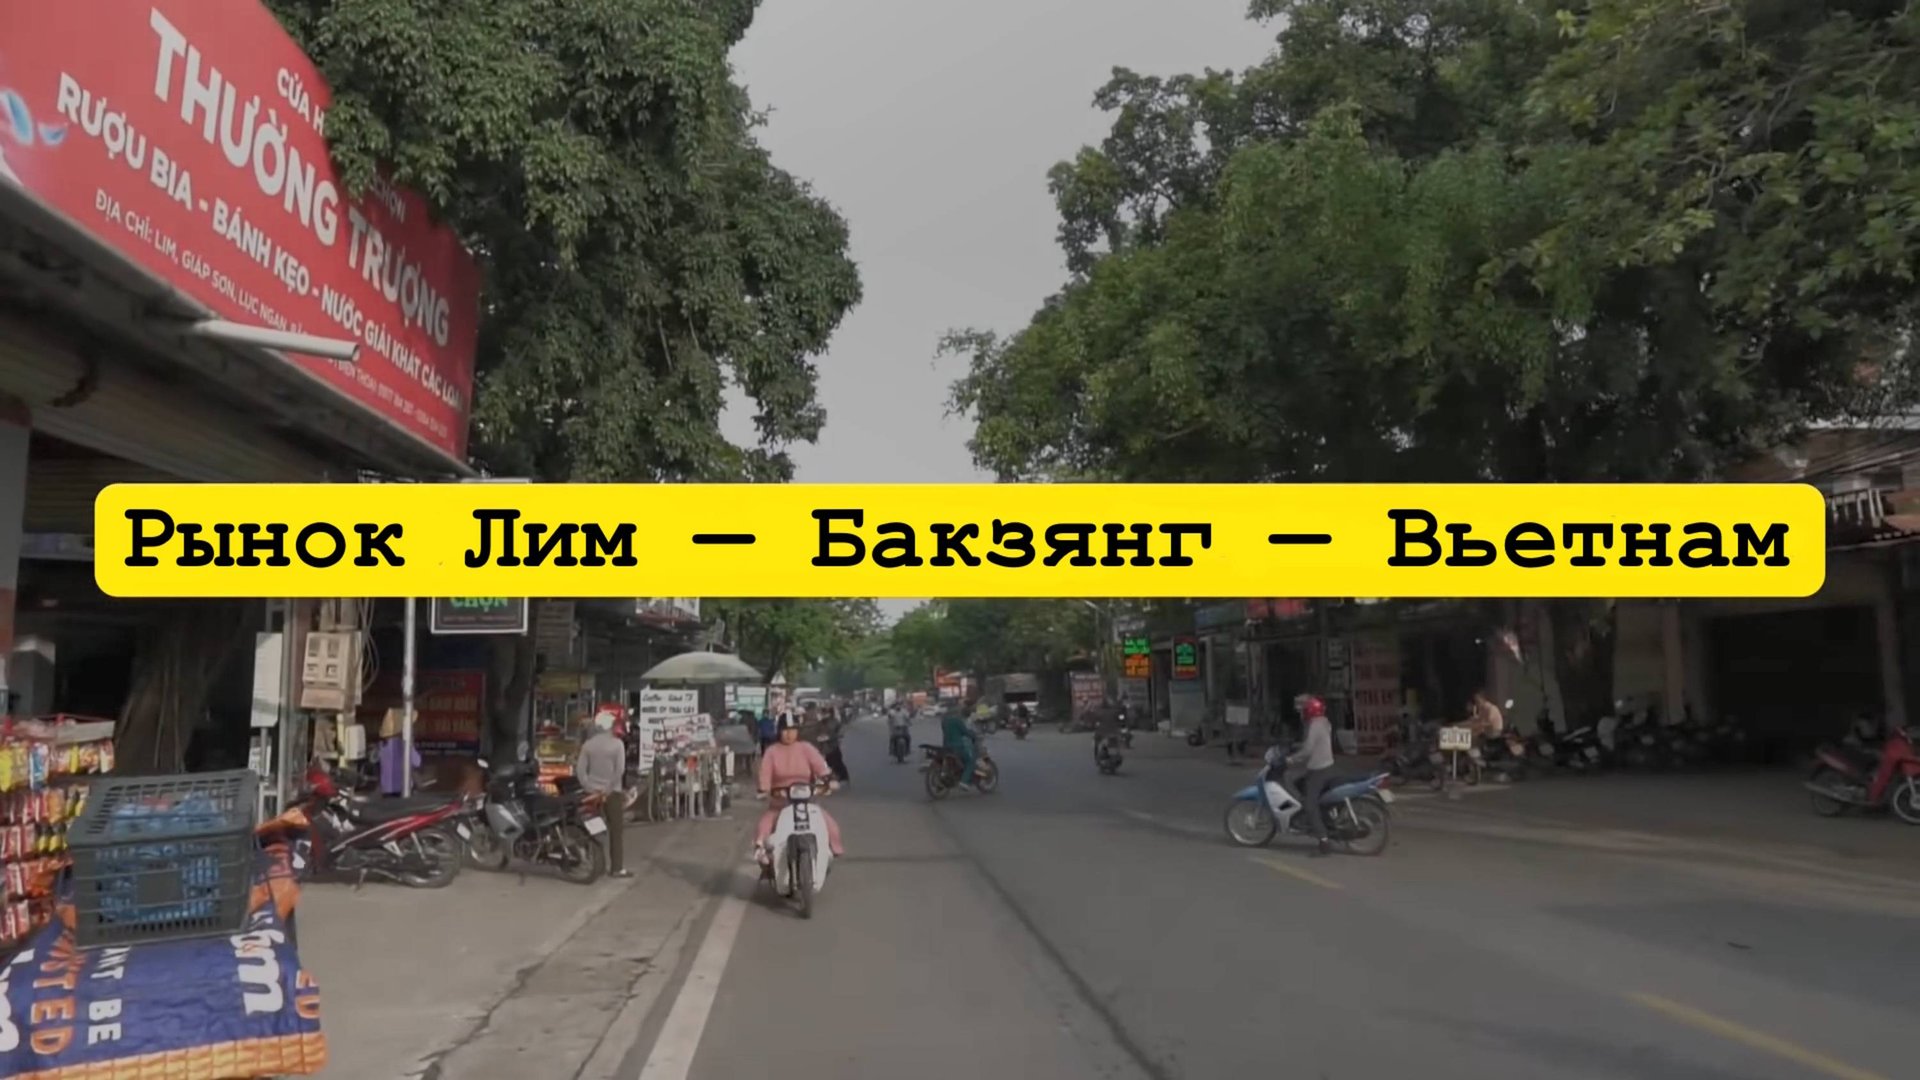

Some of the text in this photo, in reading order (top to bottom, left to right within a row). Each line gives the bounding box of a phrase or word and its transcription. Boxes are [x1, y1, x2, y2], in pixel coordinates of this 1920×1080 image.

[277, 67, 310, 122] CỬA
[57, 72, 146, 170] RƯỢU
[150, 150, 193, 211] BIA
[212, 197, 272, 268] BÁNH
[273, 245, 310, 295] KẸO
[150, 7, 449, 347] THƯỜNG TRƯỢNG
[95, 188, 121, 222] ĐỊA
[181, 249, 211, 280] GIÁP
[87, 999, 122, 1045] BE
